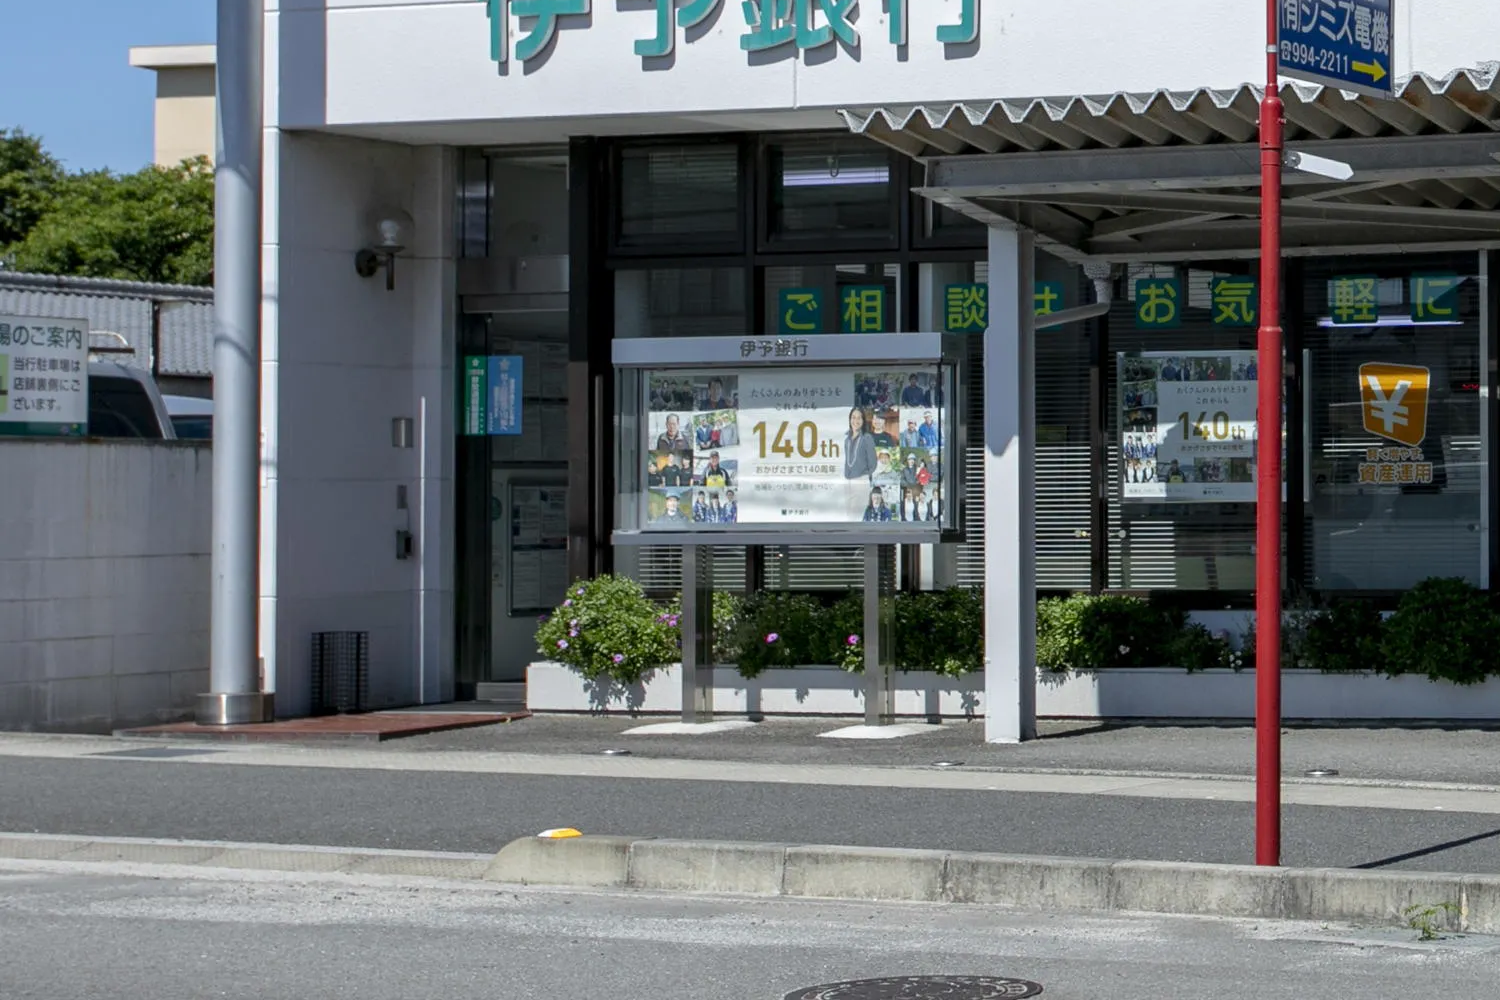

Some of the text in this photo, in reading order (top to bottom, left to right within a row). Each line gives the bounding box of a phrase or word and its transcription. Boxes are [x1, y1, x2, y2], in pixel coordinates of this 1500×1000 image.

[1291, 42, 1349, 75] 994-2211
[740, 339, 808, 357] 伊予銀行
[752, 420, 839, 458] 140th
[1178, 411, 1246, 440] 140th
